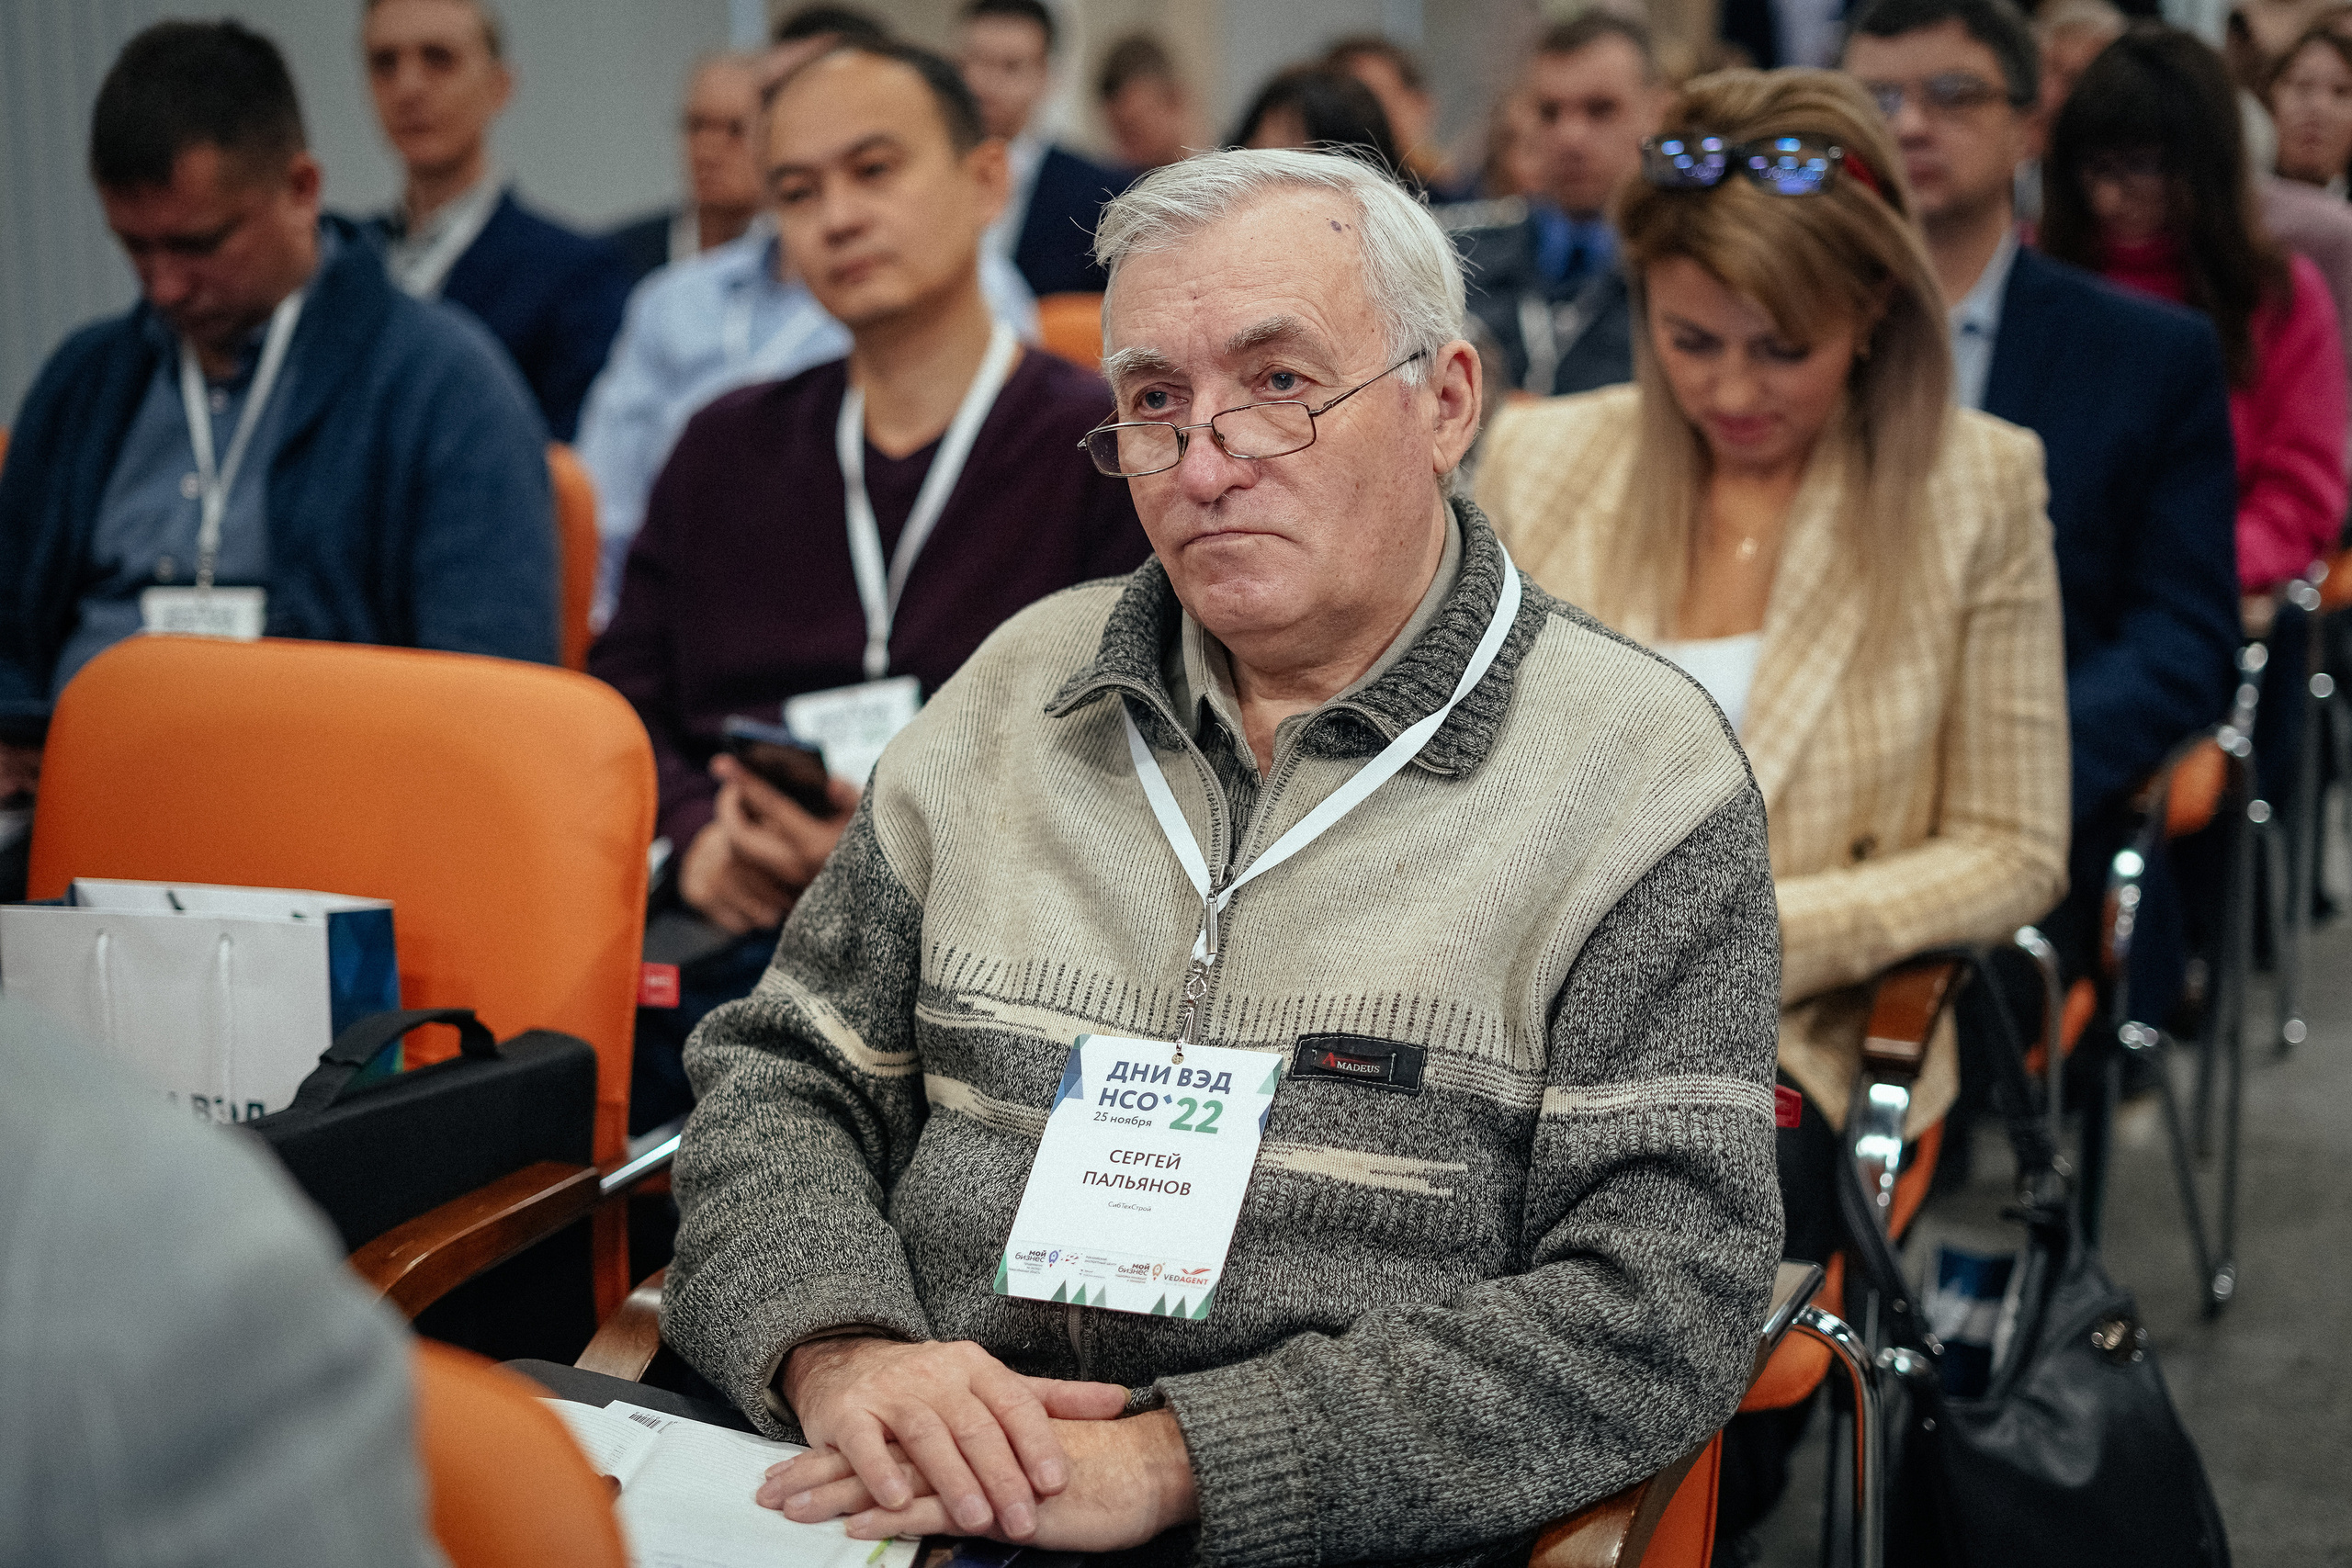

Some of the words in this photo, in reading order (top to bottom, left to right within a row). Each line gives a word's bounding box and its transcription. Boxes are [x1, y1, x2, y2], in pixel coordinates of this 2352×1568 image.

[1322, 1052, 1380, 1073] AMADEUS
[1106, 1061, 1172, 1085] ДНИ
[1176, 1067, 1233, 1095] ВЭД
[1098, 1087, 1159, 1111] НСО
[1093, 1111, 1109, 1122] 25
[1110, 1115, 1152, 1128] ноября
[1109, 1149, 1182, 1170] СЕРГЕЙ
[1082, 1170, 1192, 1196] ПАЛЬЯНОВ
[1163, 1273, 1209, 1286] VEDAGENT
